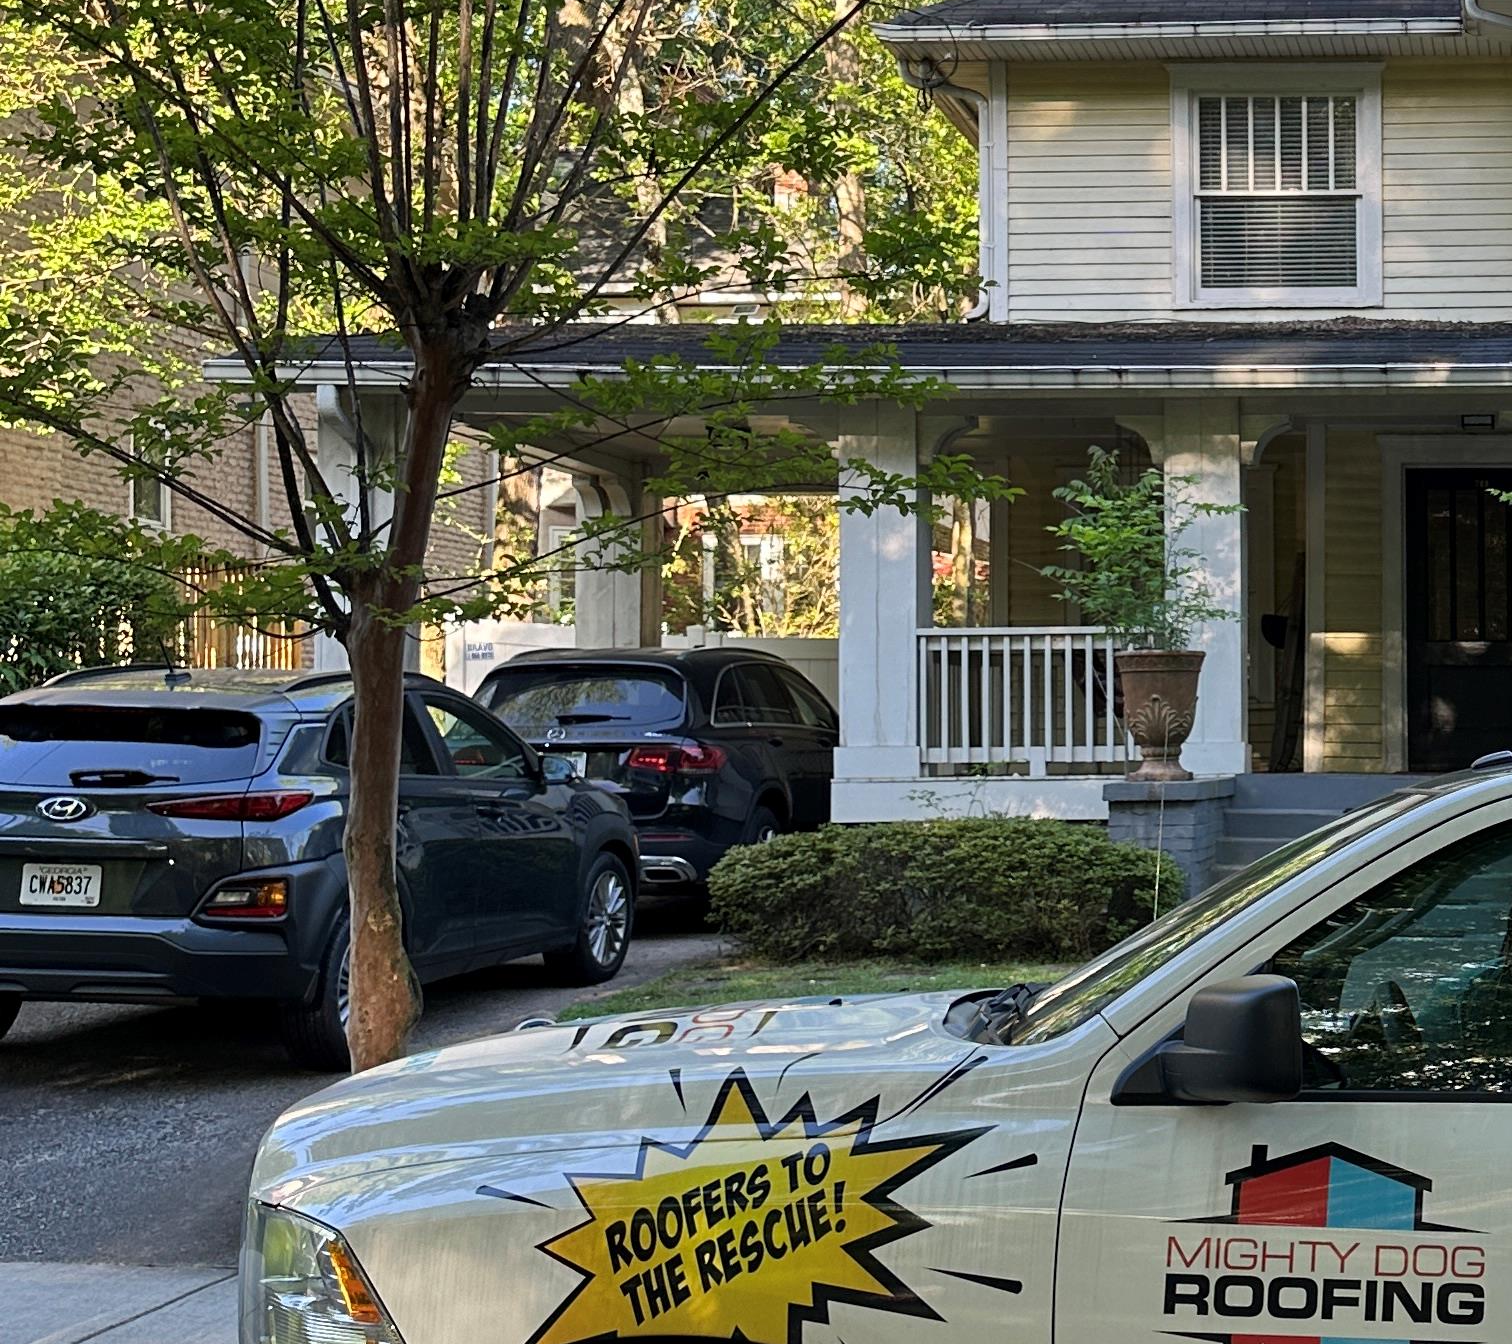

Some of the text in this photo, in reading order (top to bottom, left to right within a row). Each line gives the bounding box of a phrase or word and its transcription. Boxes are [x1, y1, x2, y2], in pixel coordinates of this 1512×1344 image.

[30, 875, 92, 895] CWA5837
[604, 1142, 831, 1274] ROOFERS TO
[620, 1180, 847, 1326] THE RESCUE!
[1166, 1236, 1485, 1278] MIGHTY DOG
[1163, 1273, 1485, 1325] ROOFING
